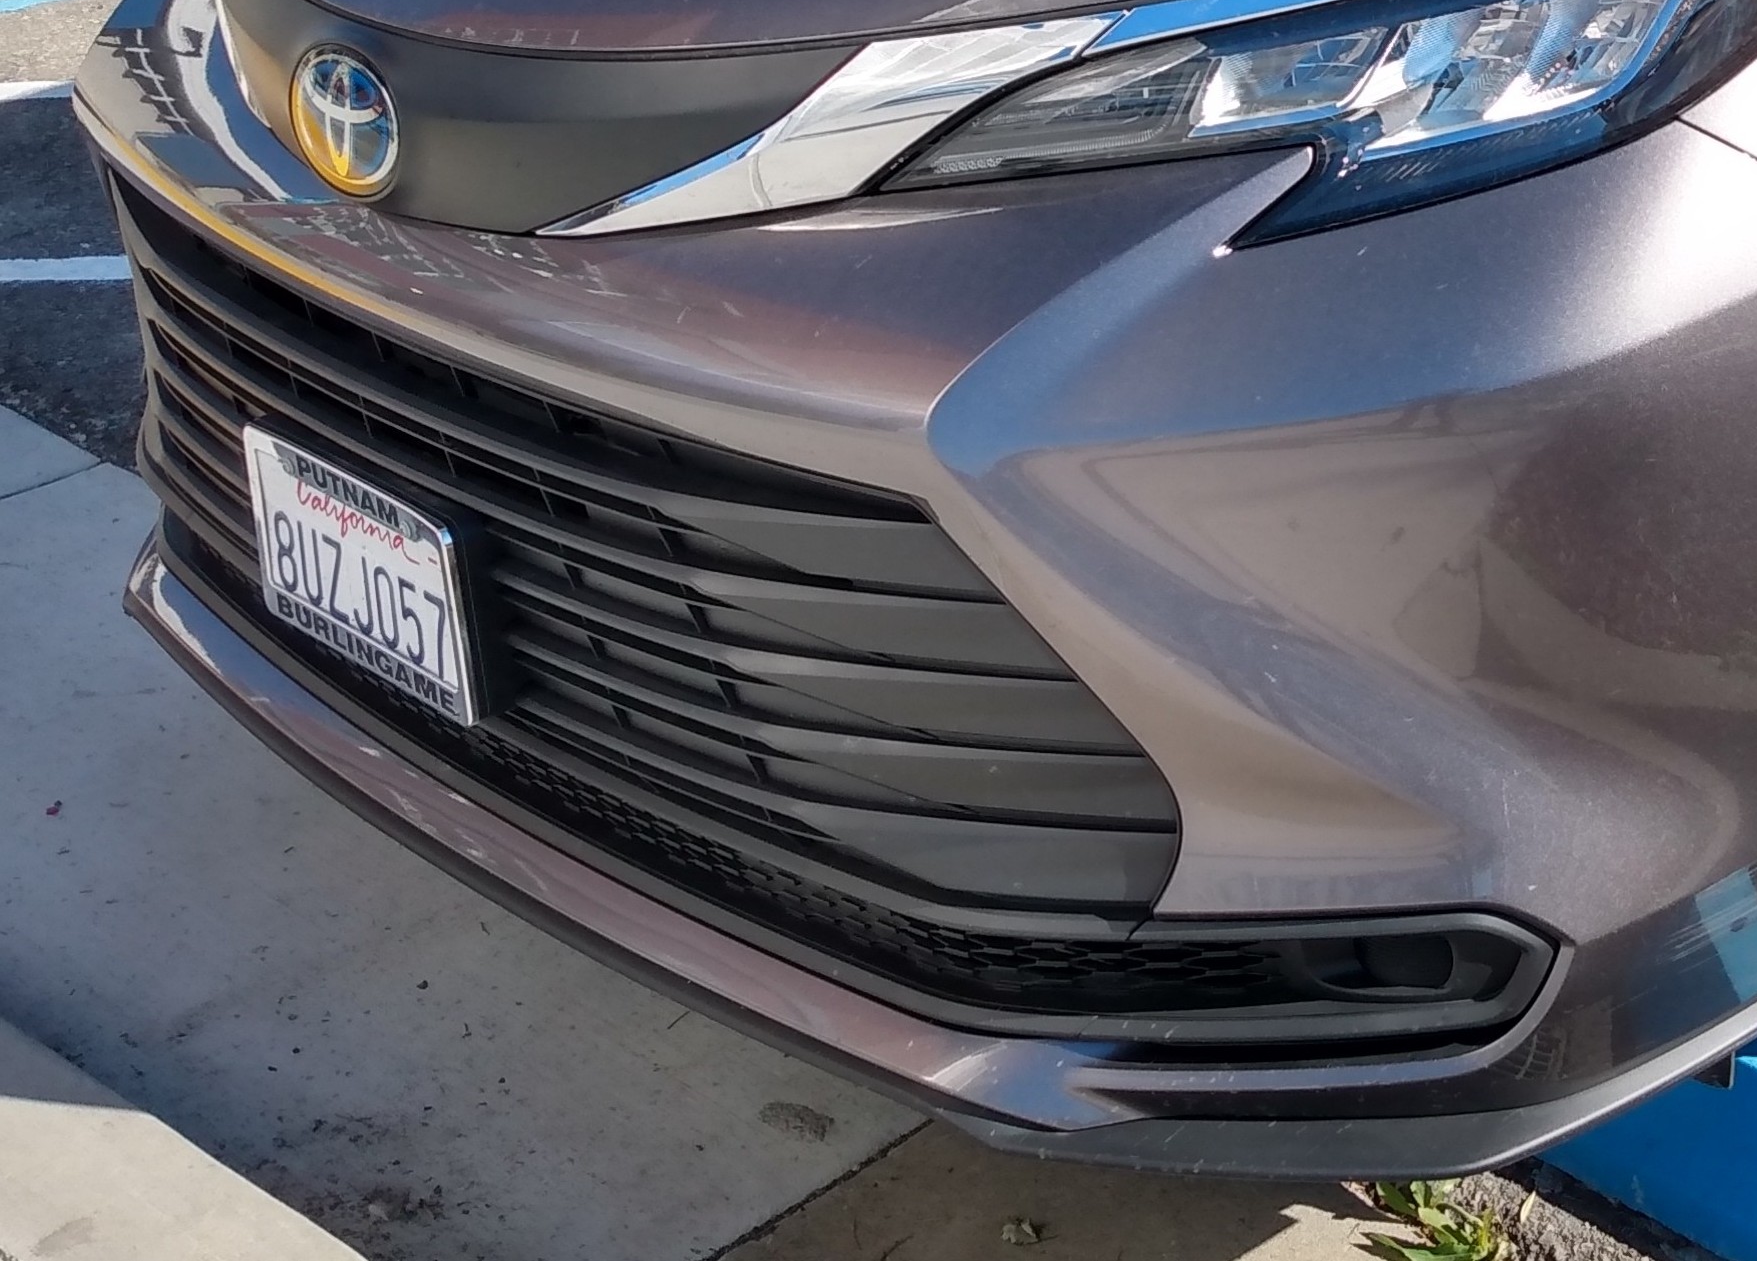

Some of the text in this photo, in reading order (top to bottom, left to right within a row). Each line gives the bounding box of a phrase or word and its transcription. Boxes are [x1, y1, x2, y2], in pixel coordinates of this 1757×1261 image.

[294, 453, 400, 526] PUTNAM
[297, 478, 420, 565] California
[274, 510, 447, 682] 8UZJ057
[276, 592, 456, 716] BURLINGAME
